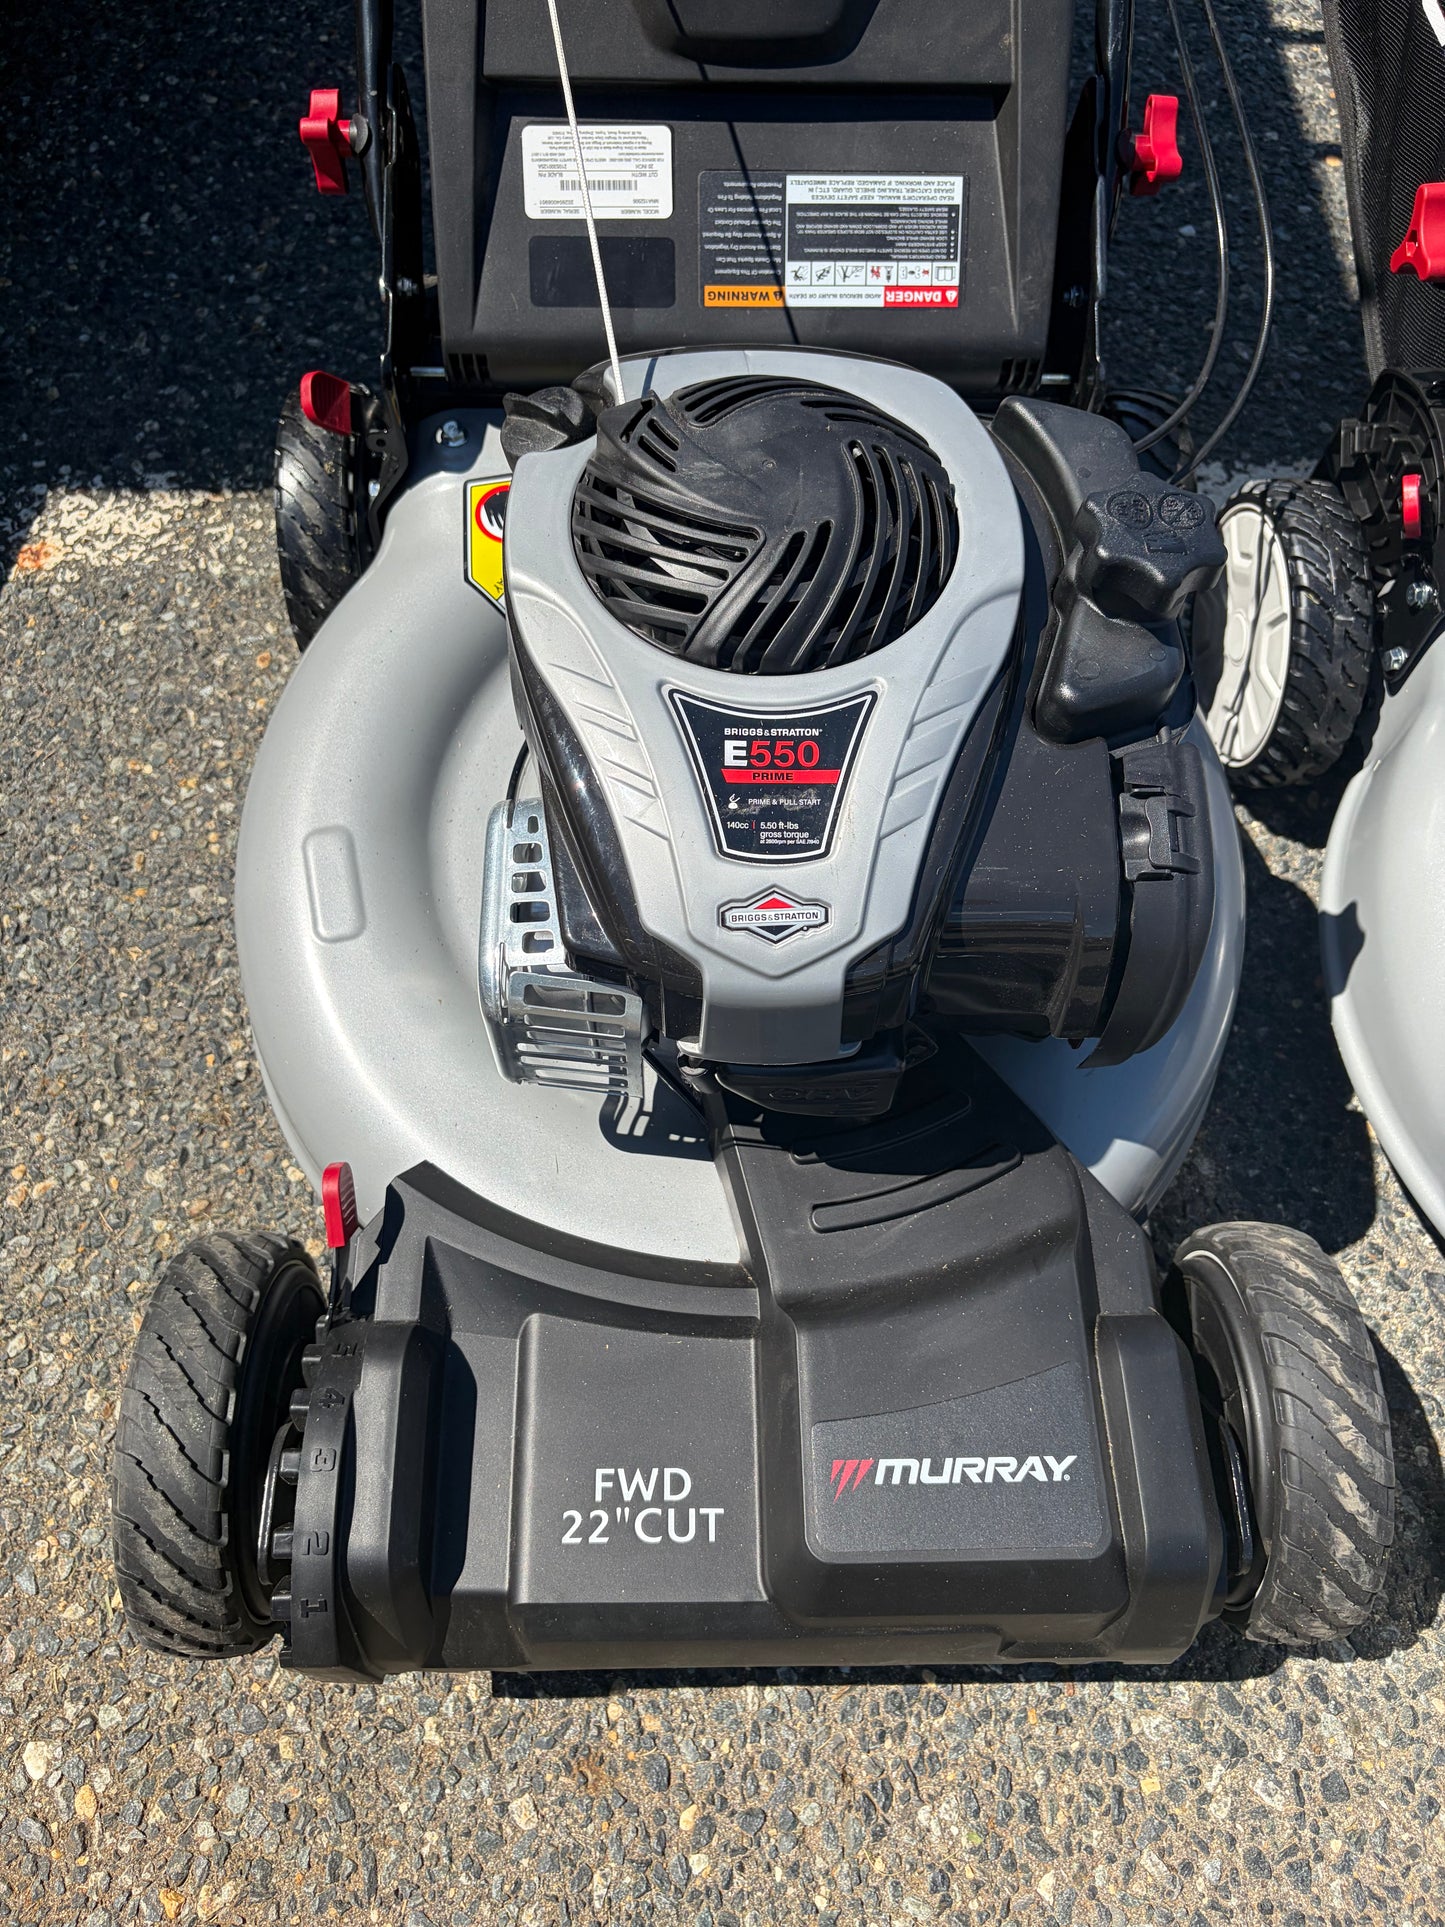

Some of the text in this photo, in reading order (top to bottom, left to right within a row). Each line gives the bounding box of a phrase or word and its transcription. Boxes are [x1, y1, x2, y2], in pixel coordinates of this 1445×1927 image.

[707, 291, 770, 301] WARNING
[885, 291, 942, 302] DANGER
[724, 740, 820, 768] E550
[752, 772, 794, 781] PRIME
[748, 798, 771, 806] PRIME
[727, 821, 749, 829] 140cc
[760, 821, 799, 830] 5.50 ft-lbs
[760, 831, 810, 839] gross torque
[318, 1386, 345, 1408] 4
[309, 1448, 337, 1472] 3
[595, 1467, 692, 1502] FWD
[301, 1531, 330, 1556] 2
[300, 1598, 328, 1618] 1
